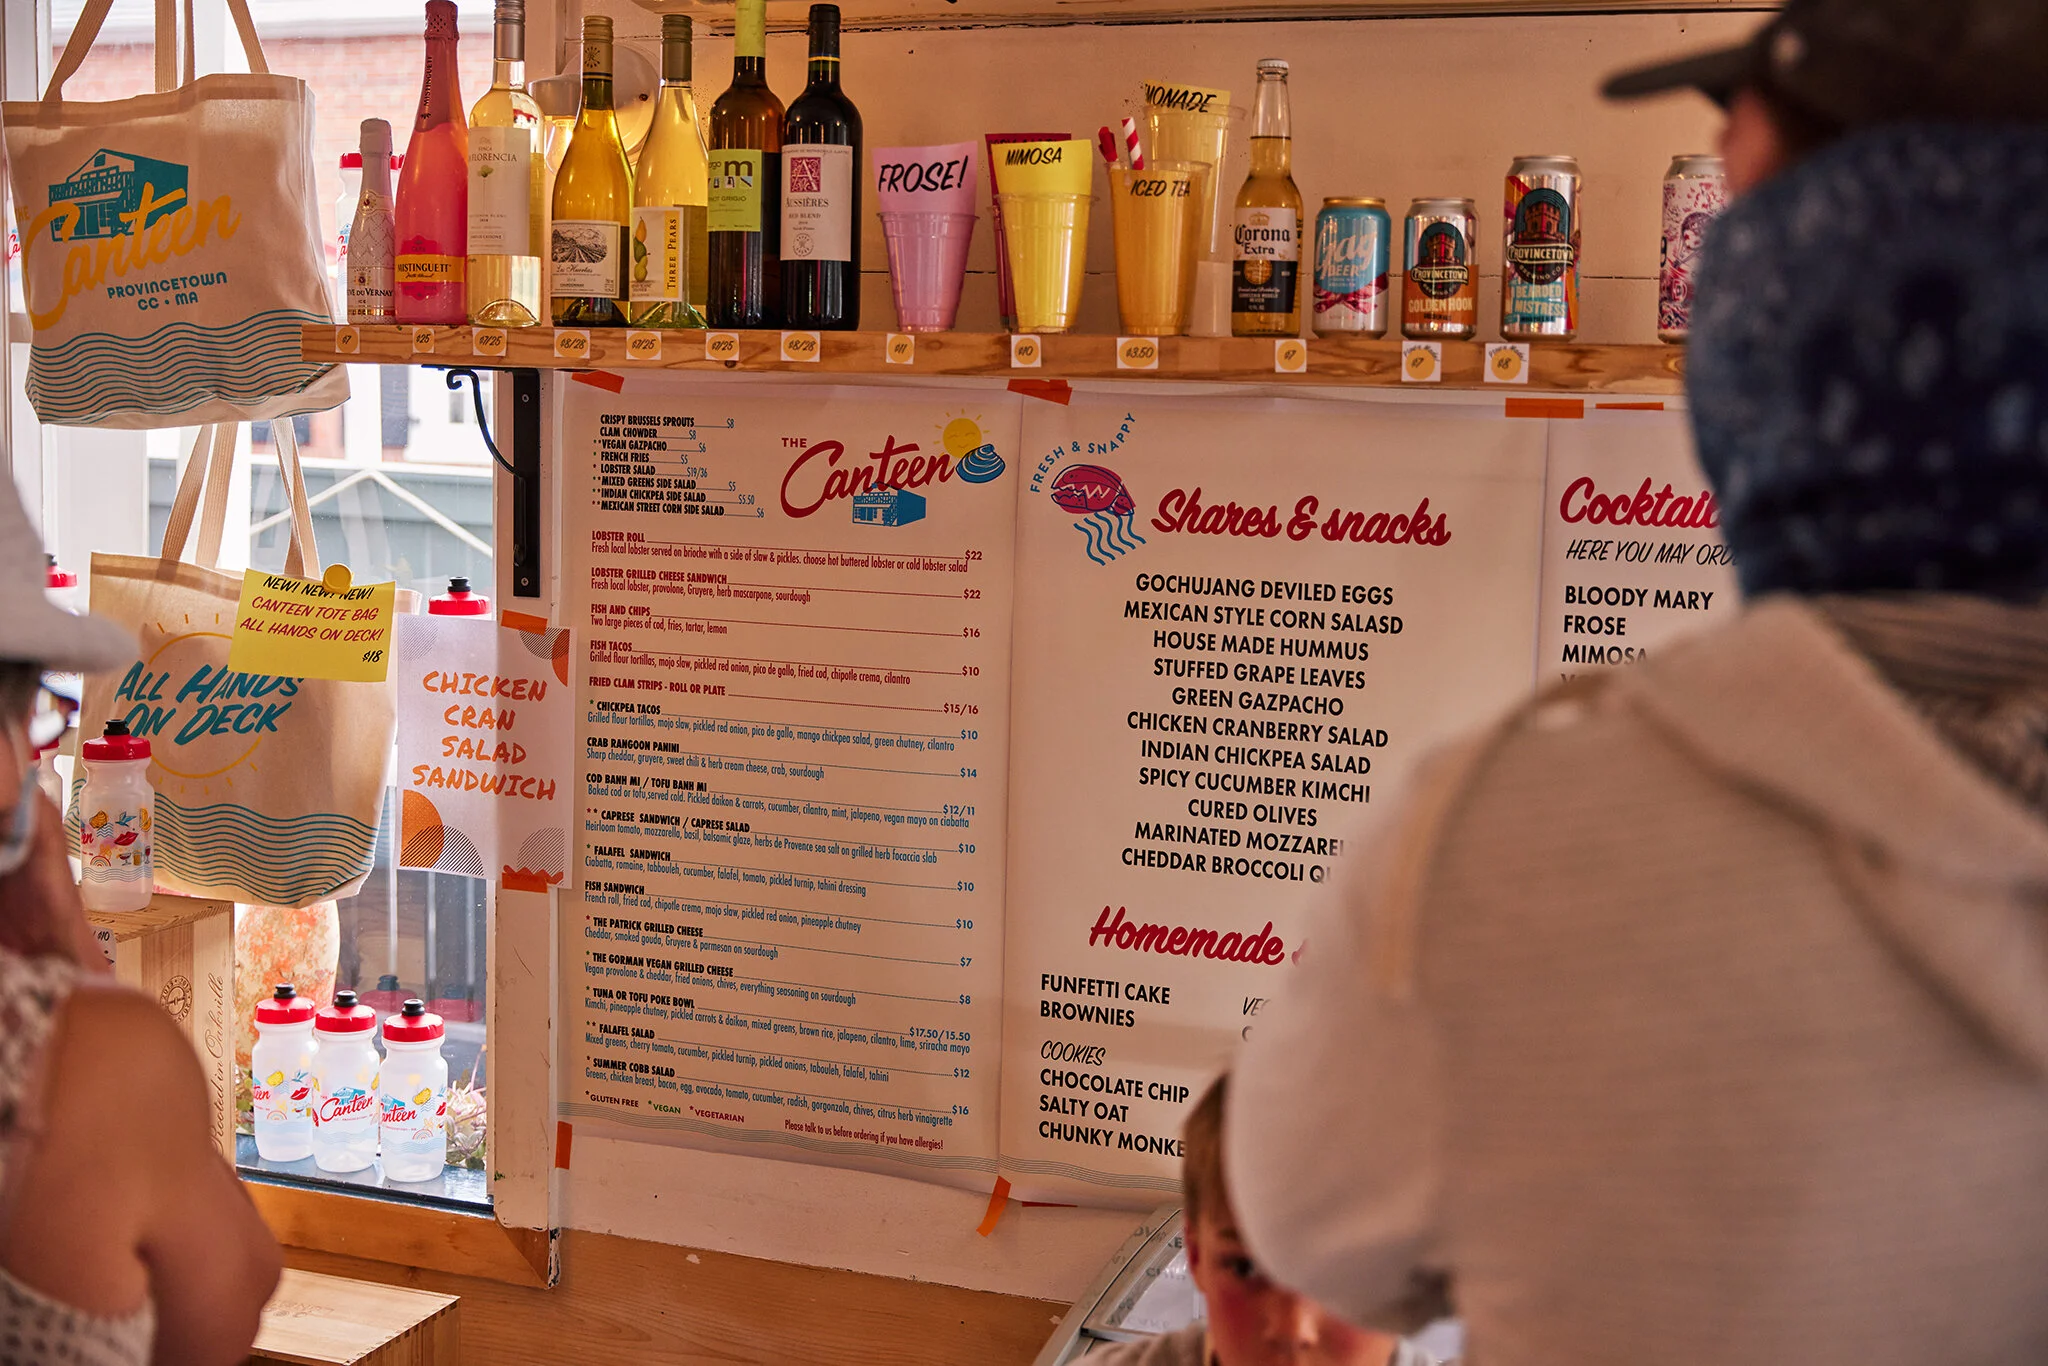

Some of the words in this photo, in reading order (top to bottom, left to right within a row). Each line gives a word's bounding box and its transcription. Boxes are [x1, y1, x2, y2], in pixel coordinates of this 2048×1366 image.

[1005, 147, 1063, 167] MIMOSA
[877, 155, 968, 194] FROSE!
[1130, 179, 1167, 197] ICED
[1171, 180, 1190, 197] TEA
[666, 219, 676, 250] PEARS
[1235, 224, 1290, 245] Corona
[24, 181, 242, 332] Canteen
[1244, 243, 1275, 255] Extra
[107, 271, 228, 299] PROVINCETOWN
[666, 256, 676, 289] THREE
[137, 298, 158, 311] CC
[175, 291, 199, 305] MA
[365, 288, 393, 297] VERNAY
[600, 414, 625, 425] CRISPY
[628, 415, 660, 426] BRUSSELS
[663, 416, 695, 427] SPROUTS
[600, 427, 620, 437] CLAM
[623, 427, 657, 438] CHOWDER
[602, 439, 627, 450] VEGAN
[629, 440, 667, 451] GAZPACHO
[781, 437, 807, 447] THE
[1030, 446, 1065, 494] FRESH
[1071, 440, 1082, 453] &
[1087, 413, 1136, 455] SNAPPY
[601, 451, 628, 462] FRENCH
[631, 452, 649, 463] FRIES
[601, 463, 631, 474] LOBSTER
[633, 465, 656, 476] SALAD
[602, 476, 625, 486] MIXED
[628, 477, 654, 488] GREENS
[656, 478, 672, 488] SIDE
[674, 479, 696, 490] SALAD
[780, 434, 956, 519] Canteen
[602, 488, 627, 499] INDIAN
[629, 489, 664, 501] CHICKPEA
[666, 491, 682, 501] SIDE
[684, 492, 706, 502] SALAD
[1150, 486, 1282, 538] Shares
[1286, 495, 1320, 543] &
[1321, 497, 1452, 546] snacks
[592, 530, 624, 542] LOBSTER
[627, 532, 645, 543] ROLL
[965, 550, 983, 561] $22
[1566, 539, 1614, 560] HERE
[1615, 541, 1654, 563] YOU
[1654, 543, 1694, 564] MAY
[263, 576, 300, 593] NEW!
[592, 567, 623, 578] LOBSTER
[626, 569, 656, 580] GRILLED
[659, 571, 685, 582] CHEESE
[687, 572, 727, 584] SANDWICH
[1136, 573, 1255, 598] GOCHUJANG
[1261, 581, 1336, 602] DEVILED
[1341, 585, 1393, 606] EGGS
[252, 596, 314, 616] CANTEEN
[315, 606, 351, 621] TOTE
[351, 607, 378, 621] BAG
[1565, 585, 1648, 608] BLOODY
[1653, 590, 1713, 610] MARY
[240, 617, 265, 632] ALL
[268, 622, 317, 639] HANDS
[320, 628, 343, 641] ON
[344, 628, 384, 642] DECK!
[591, 603, 607, 614] FISH
[609, 605, 626, 615] AND
[628, 606, 650, 616] CHIPS
[963, 627, 980, 638] $16
[1124, 600, 1208, 624] MEXICAN
[1213, 607, 1265, 626] STYLE
[1269, 610, 1325, 630] CORN
[1330, 613, 1403, 635] SALASD
[1564, 615, 1626, 635] FROSE
[362, 650, 383, 663] $18
[590, 640, 607, 651] FISH
[609, 641, 632, 652] TACOS
[1154, 630, 1216, 652] HOUSE
[1221, 635, 1274, 655] MADE
[1280, 639, 1369, 661] HUMMUS
[1562, 644, 1647, 665] MIMOSA
[113, 661, 171, 703] ALL
[175, 664, 306, 705] HANDS
[422, 670, 547, 702] CHICKEN
[1154, 658, 1228, 680] STUFFED
[1233, 663, 1295, 684] GRAPE
[1300, 668, 1365, 690] LEAVES
[589, 677, 611, 688] FRIED
[613, 678, 635, 689] CLAM
[637, 680, 662, 691] STRIPS
[943, 703, 978, 716] $15/16
[1172, 687, 1233, 708] GREEN
[1239, 692, 1343, 716] GAZPACHO
[124, 706, 177, 740] ON
[174, 701, 292, 746] DECK
[443, 704, 516, 732] CRAN
[1127, 711, 1207, 735] CHICKEN
[1212, 717, 1323, 743] CRANBERRY
[1328, 726, 1389, 748] SALAD
[441, 735, 527, 765] SALAD
[587, 737, 608, 748] CRAB
[611, 739, 650, 751] RANGOON
[653, 742, 680, 753] PANINI
[960, 768, 977, 778] $14
[1141, 739, 1209, 762] INDIAN
[1214, 745, 1305, 770] CHICKPEA
[1310, 753, 1371, 775] SALAD
[412, 764, 556, 801] SANDWICH
[1139, 767, 1191, 788] SPICY
[1195, 771, 1296, 797] CUCUMBER
[1302, 781, 1371, 803] KIMCHI
[1188, 798, 1248, 820] CURED
[1253, 804, 1317, 826] OLIVES
[1135, 821, 1241, 848] MARINATED
[1246, 831, 1344, 857] MOZZARE
[594, 845, 625, 858] FALAFEL
[630, 849, 671, 862] SANDWICH
[1121, 847, 1206, 872] CHEDDAR
[1212, 856, 1304, 881] BROCCOLI
[1089, 905, 1285, 966] Homemade
[1041, 973, 1120, 998] FUNFETTI
[1125, 983, 1170, 1005] CAKE
[1040, 1000, 1135, 1028] BROWNIES
[1040, 1040, 1106, 1067] COOKIES
[593, 1058, 627, 1072] SUMMER
[629, 1061, 650, 1074] COBB
[652, 1065, 675, 1078] SALAD
[1040, 1068, 1144, 1098] CHOCOLATE
[1148, 1082, 1189, 1103] CHIP
[320, 1094, 374, 1123] Canteen
[590, 1094, 620, 1105] GLUTEN
[621, 1098, 639, 1107] FREE
[653, 1103, 681, 1114] VEGAN
[695, 1109, 744, 1122] VEGETARIAN
[1039, 1095, 1089, 1118] SALTY
[1093, 1102, 1129, 1122] OAT
[1039, 1121, 1113, 1148] CHUNKY
[1118, 1131, 1185, 1157] MONKE
